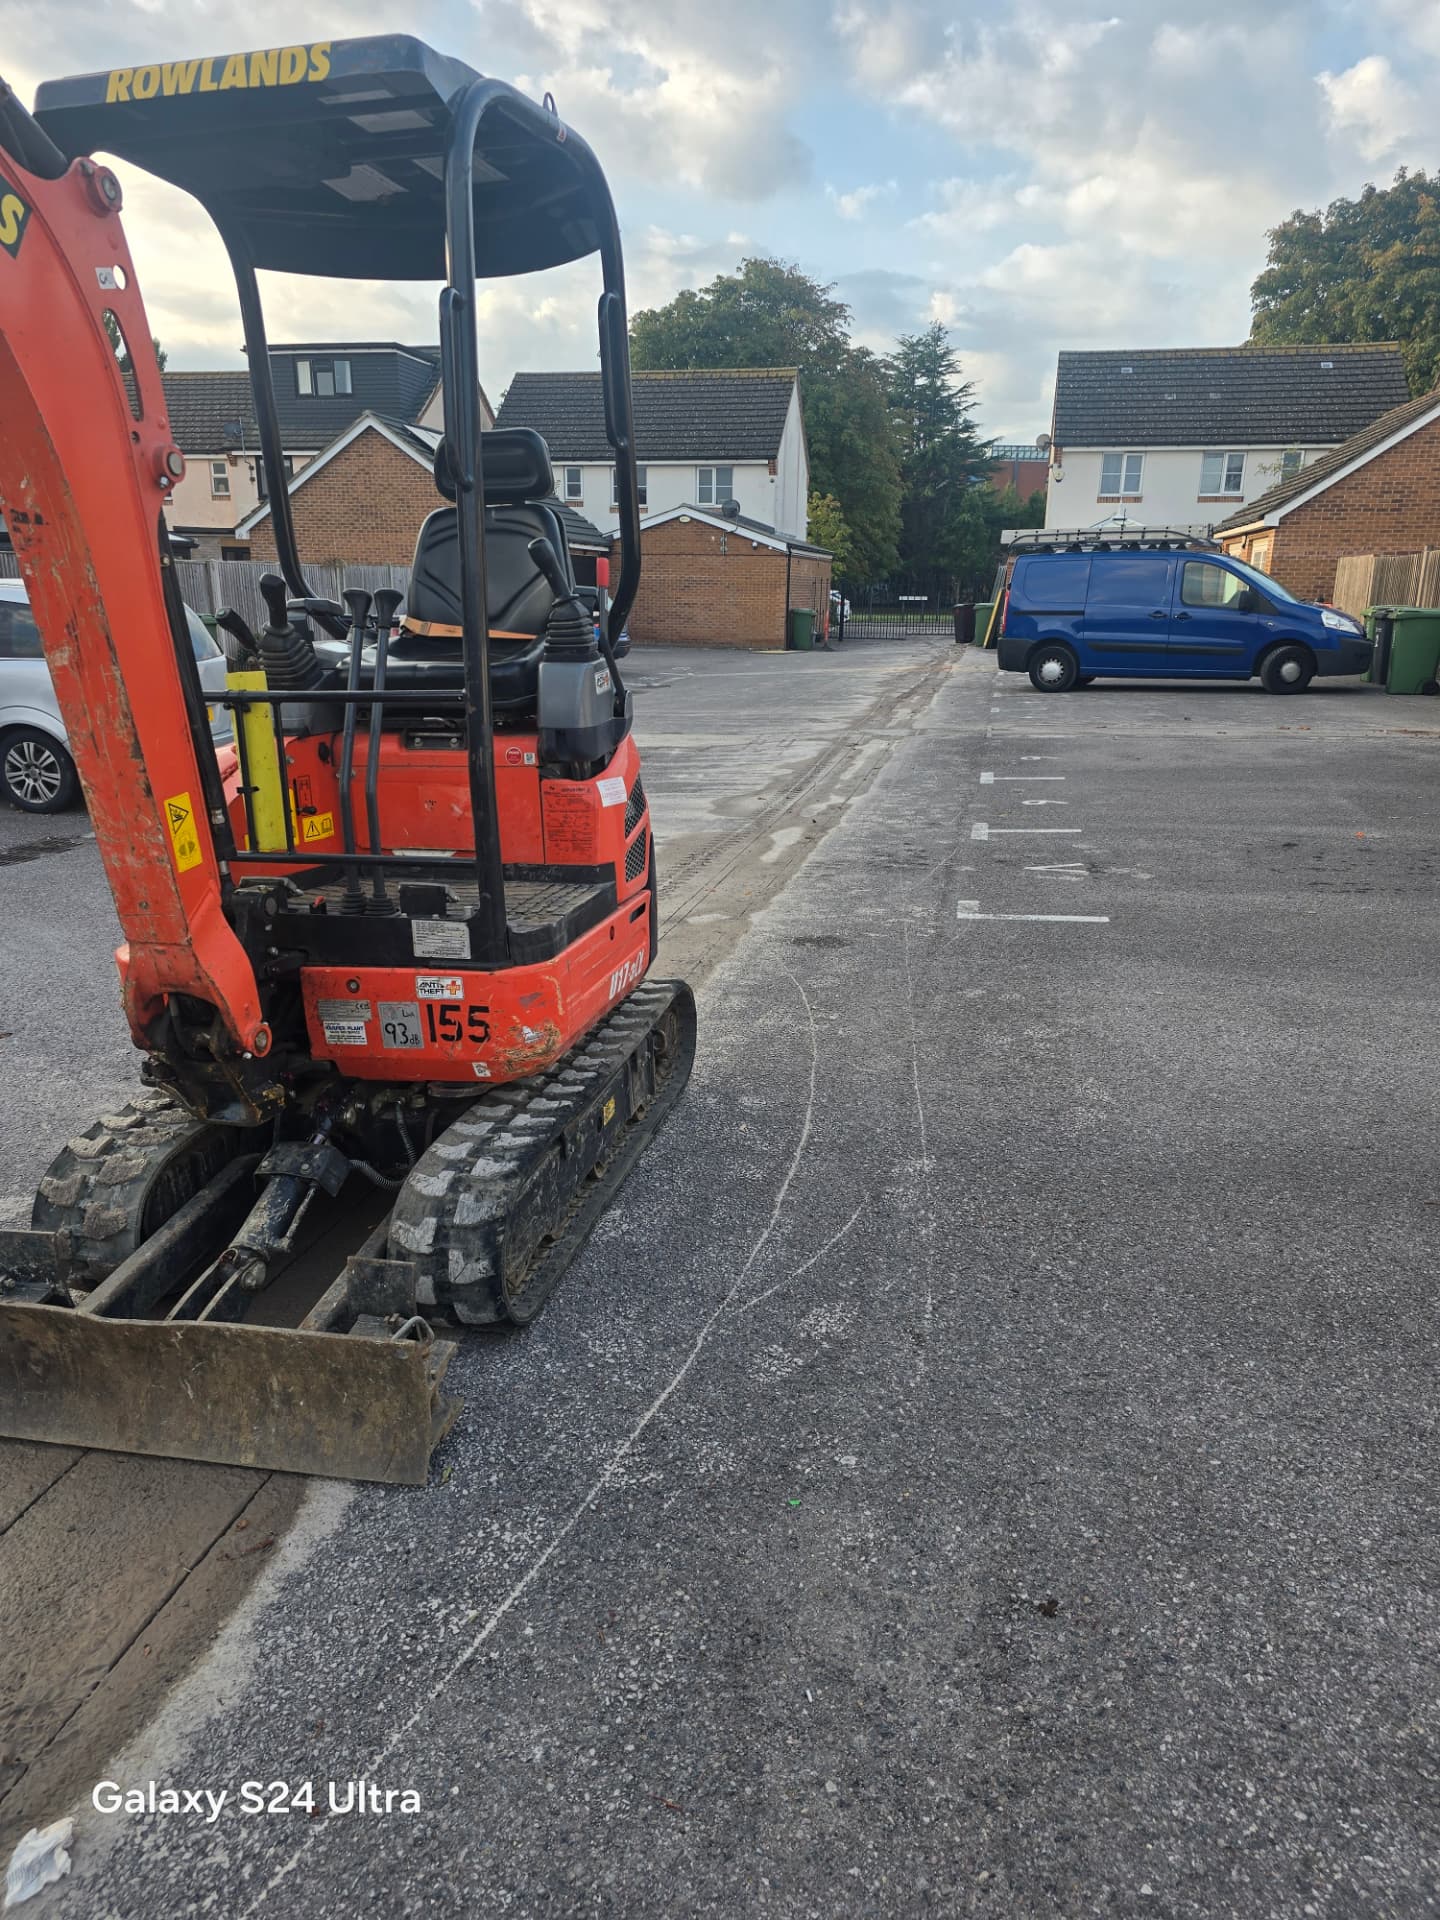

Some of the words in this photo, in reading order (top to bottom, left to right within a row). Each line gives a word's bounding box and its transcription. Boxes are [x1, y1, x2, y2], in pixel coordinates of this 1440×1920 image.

[105, 41, 331, 104] ROWLANDS
[384, 1022, 409, 1045] 93
[426, 1003, 491, 1044] 155
